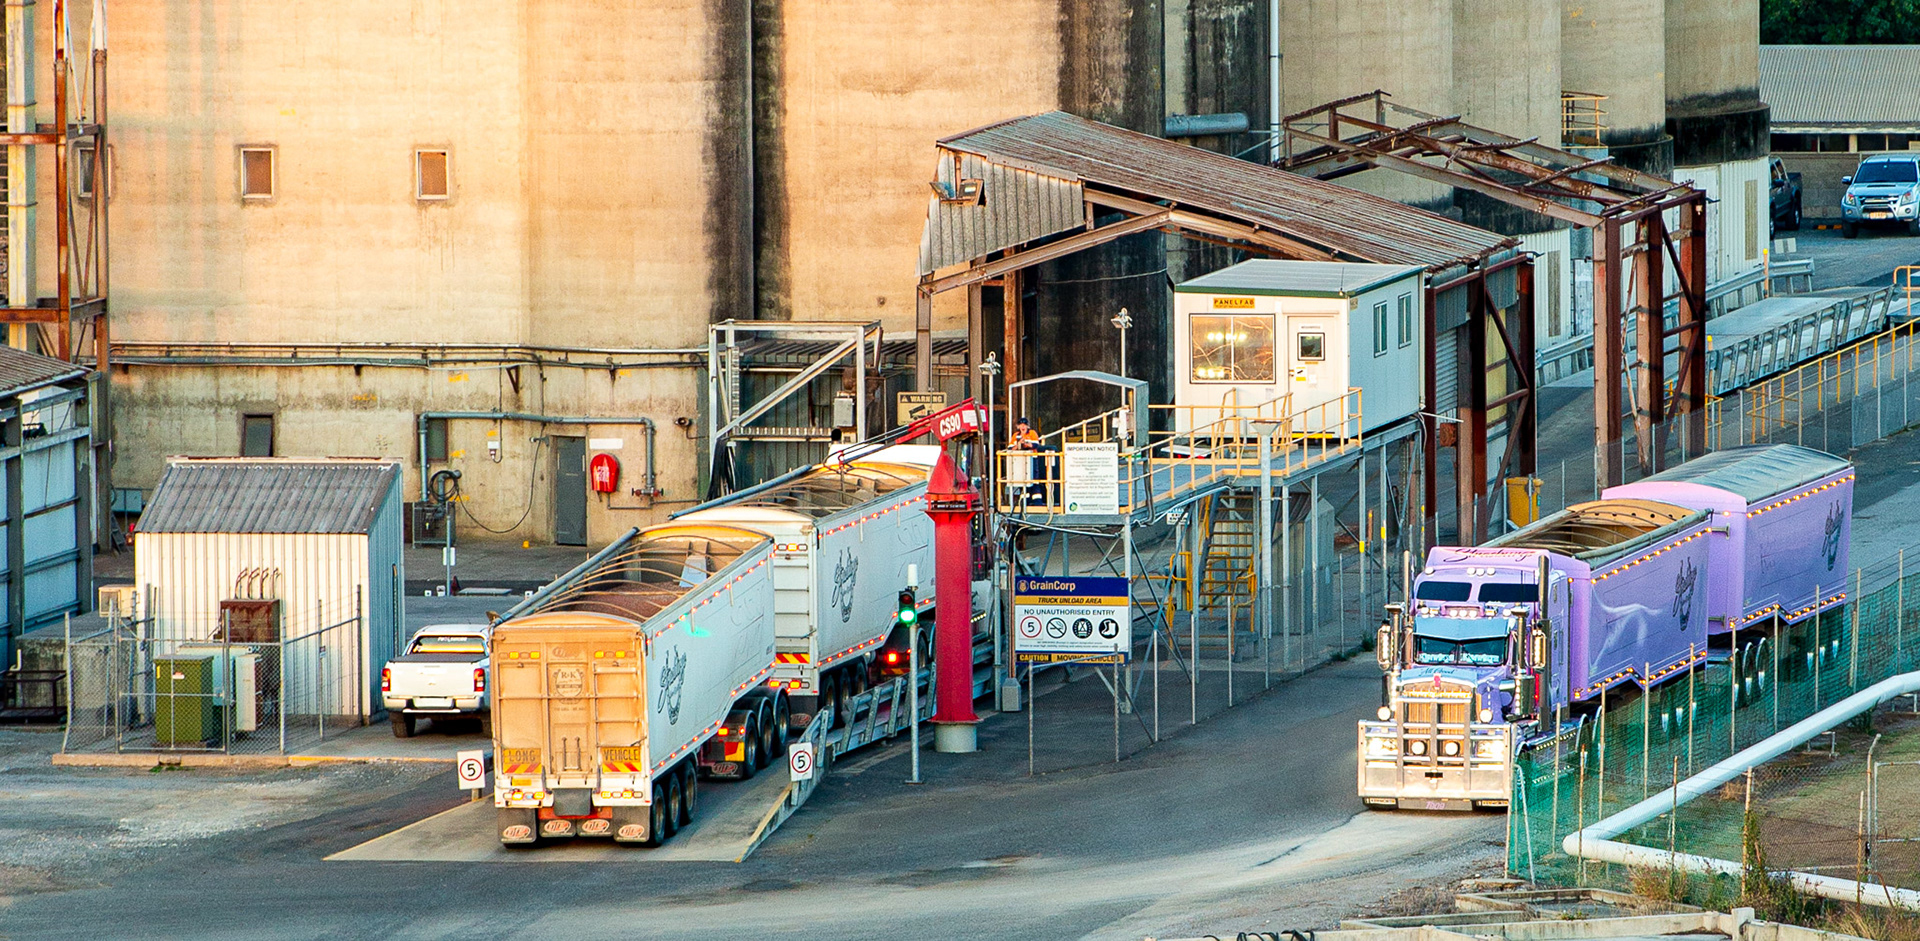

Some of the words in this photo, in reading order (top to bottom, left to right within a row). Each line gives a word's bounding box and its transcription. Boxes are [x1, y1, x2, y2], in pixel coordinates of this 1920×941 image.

[940, 413, 961, 437] CS90
[1029, 580, 1076, 592] GrainCorp
[1027, 621, 1035, 633] 5
[1019, 654, 1049, 662] CAUTION
[508, 749, 536, 762] LONG
[603, 749, 639, 762] VEHICLE
[797, 755, 805, 769] 5
[467, 763, 476, 777] 5
